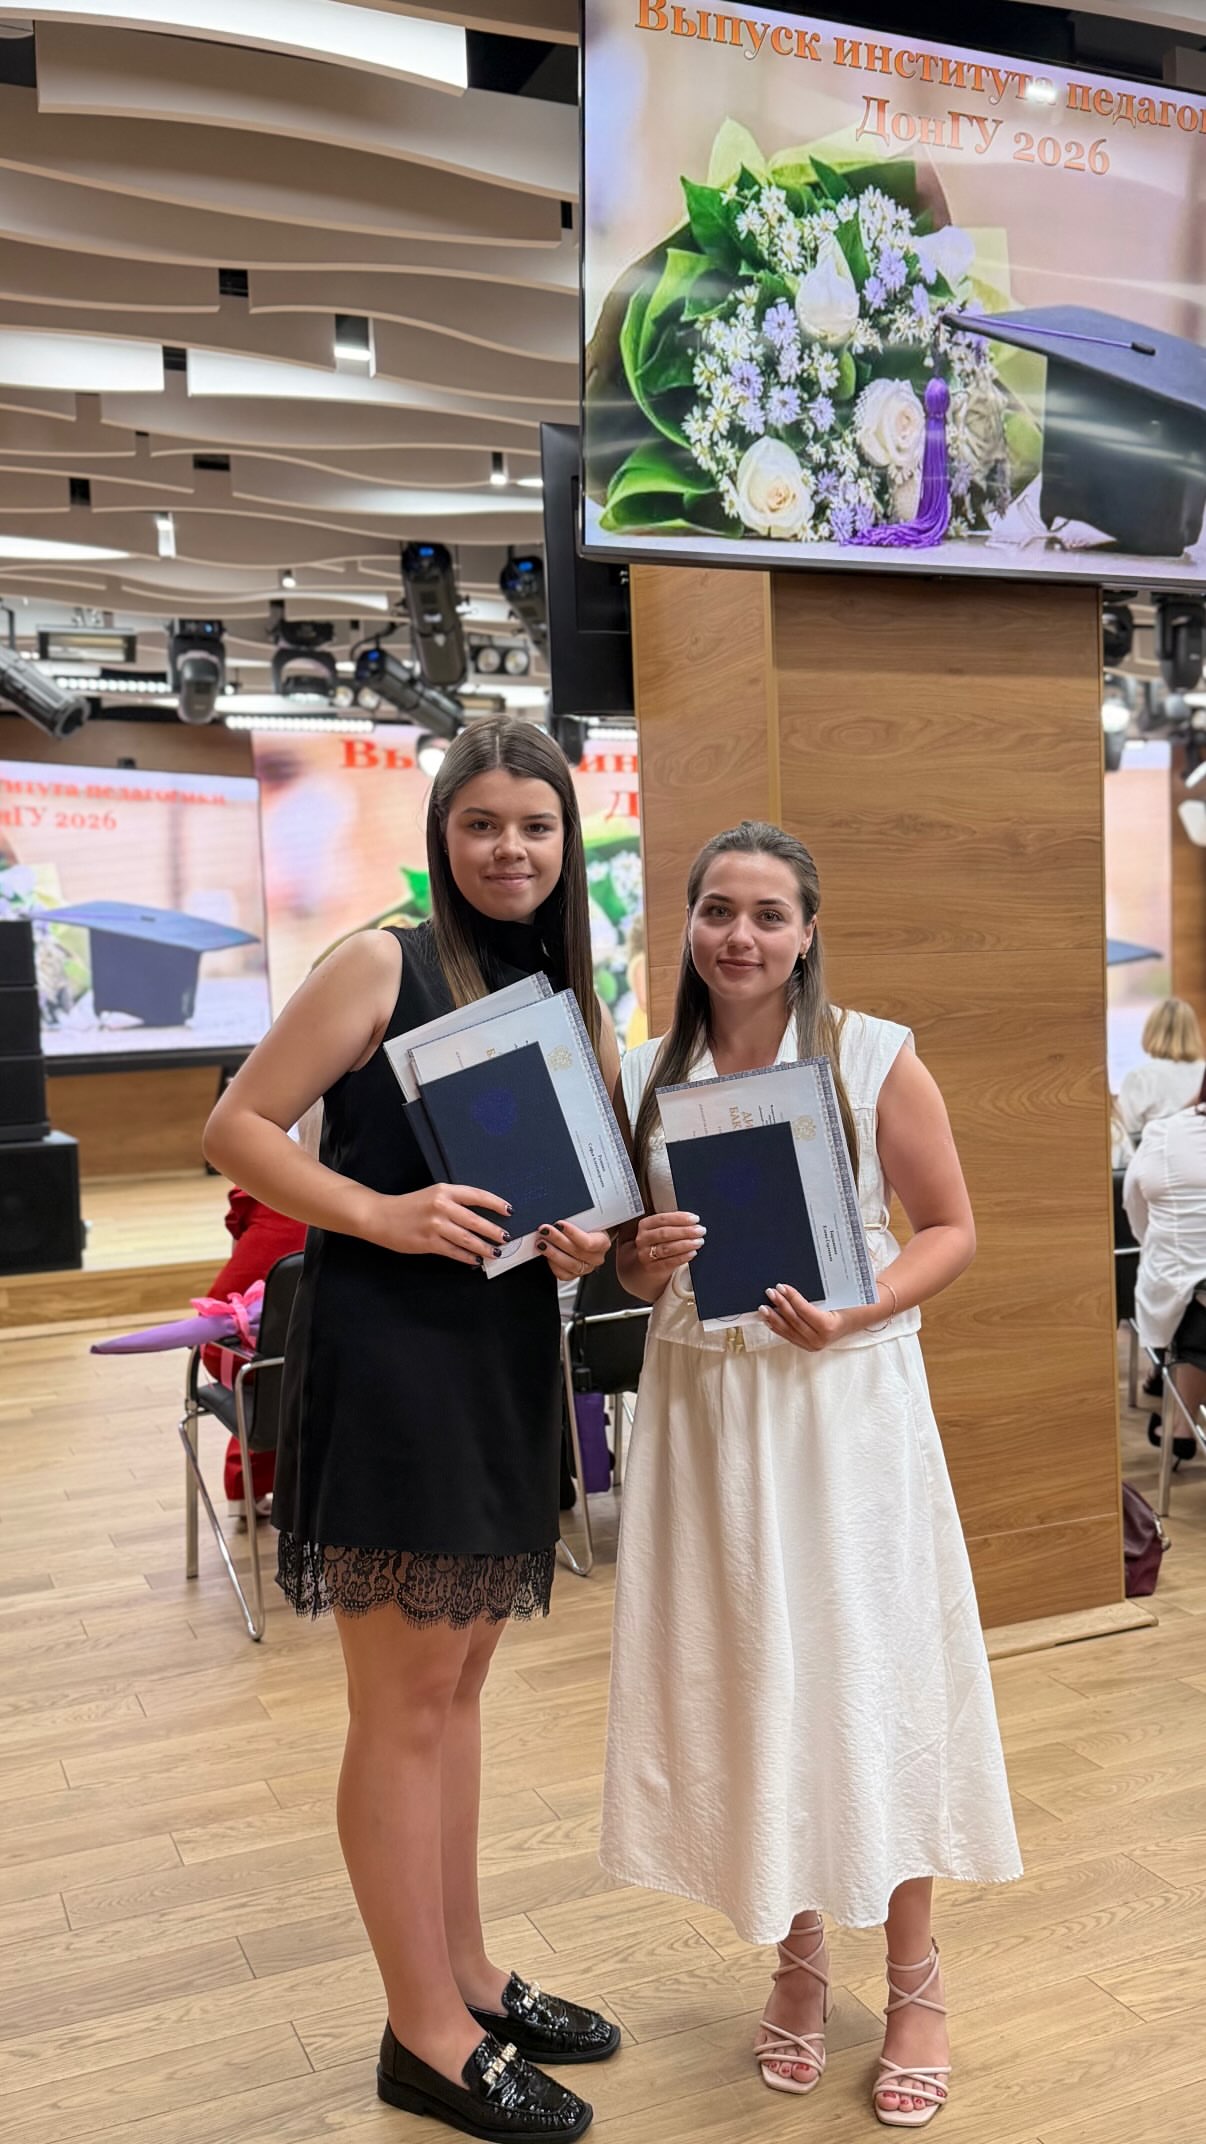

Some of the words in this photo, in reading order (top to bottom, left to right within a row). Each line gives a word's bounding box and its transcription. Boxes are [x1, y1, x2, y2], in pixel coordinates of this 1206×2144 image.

[635, 0, 822, 61] Выпуск
[856, 95, 1004, 155] ДонГУ
[1013, 131, 1111, 175] 2026
[55, 809, 118, 831] 2026
